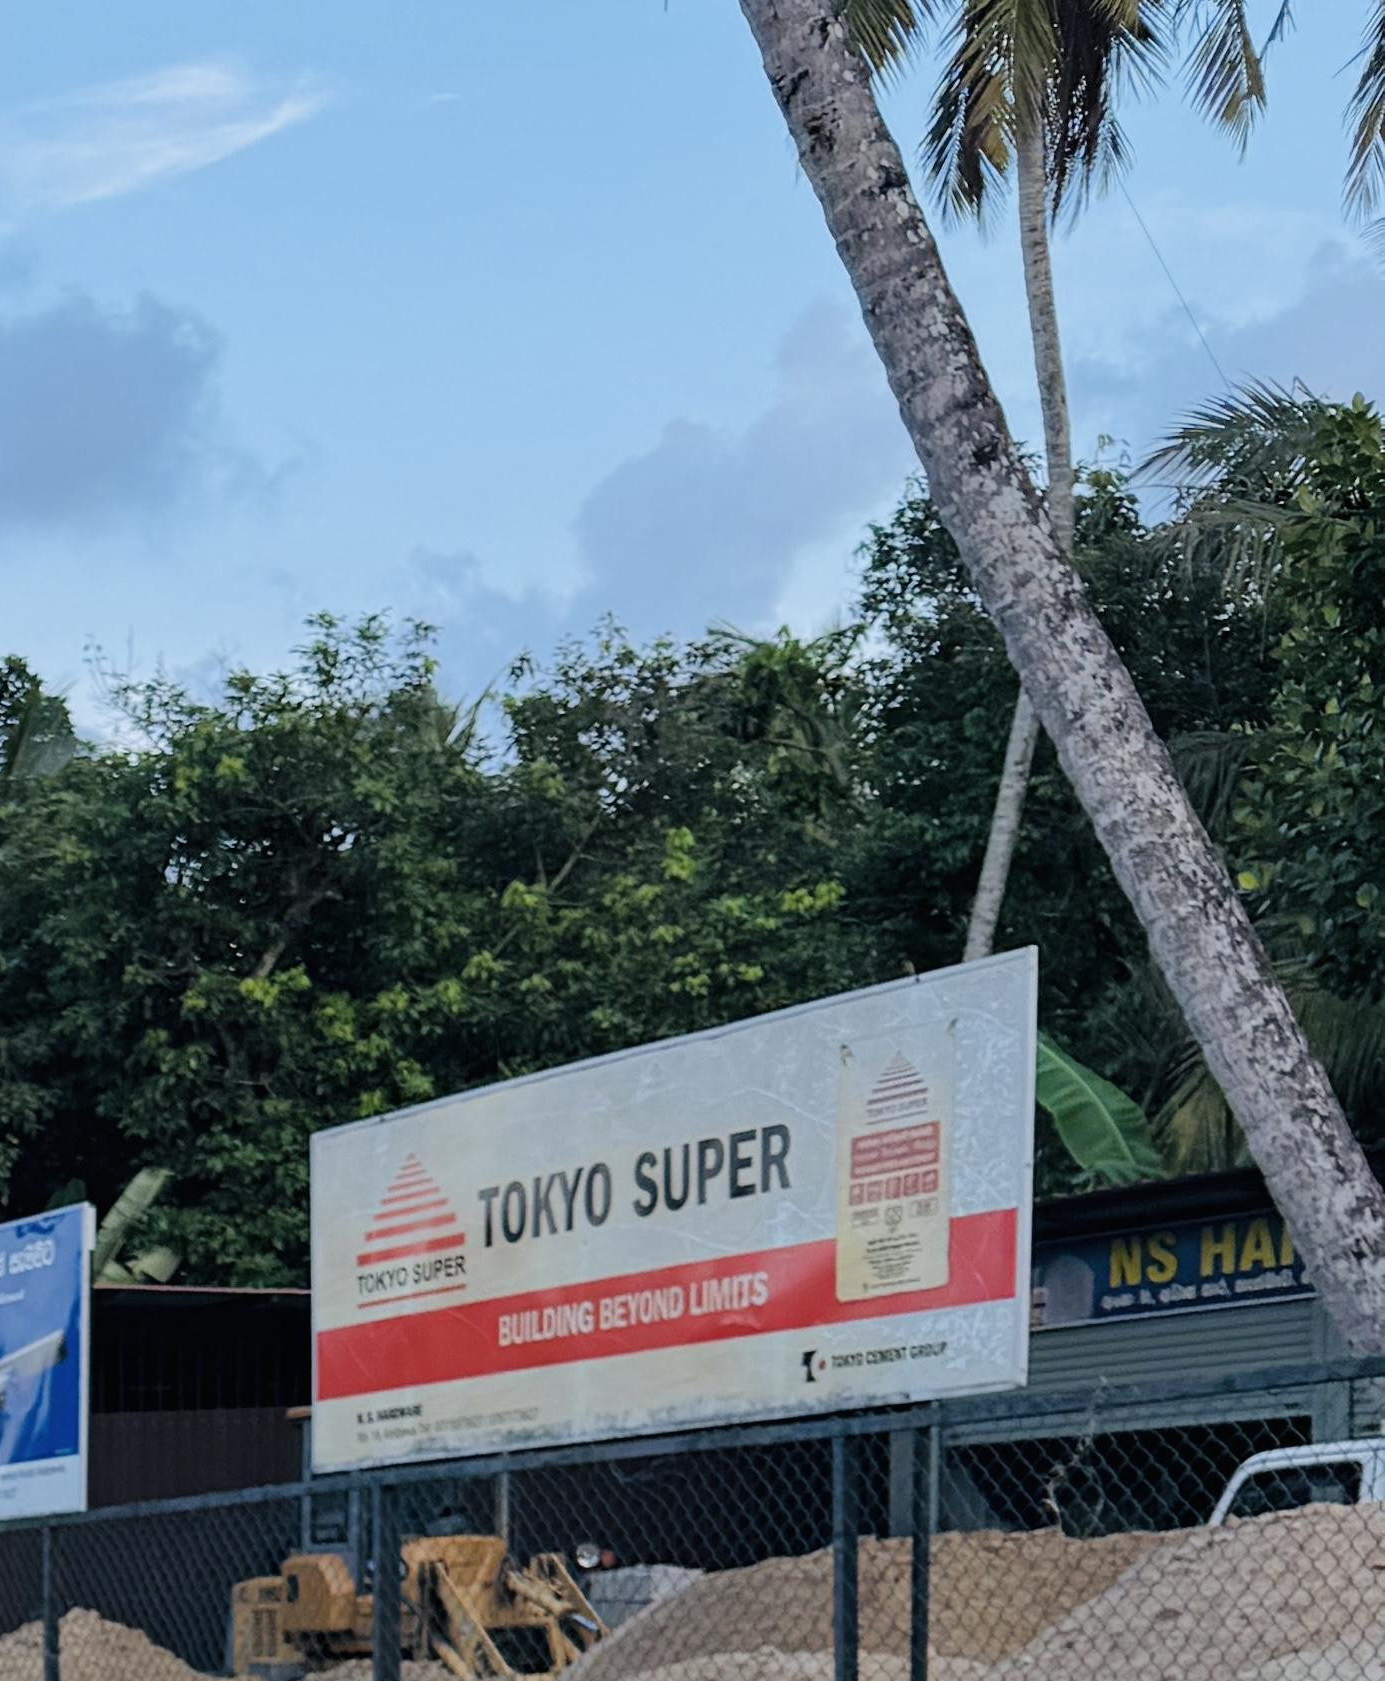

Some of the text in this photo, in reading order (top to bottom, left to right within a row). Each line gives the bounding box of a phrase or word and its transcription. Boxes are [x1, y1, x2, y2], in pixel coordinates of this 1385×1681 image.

[477, 1161, 612, 1248] TOKYO
[632, 1123, 792, 1218] SUPER
[357, 1255, 466, 1295] TOKYO SUPER
[1109, 1232, 1178, 1288] NS
[497, 1270, 769, 1347] BUILDING BEYOND LIMITS
